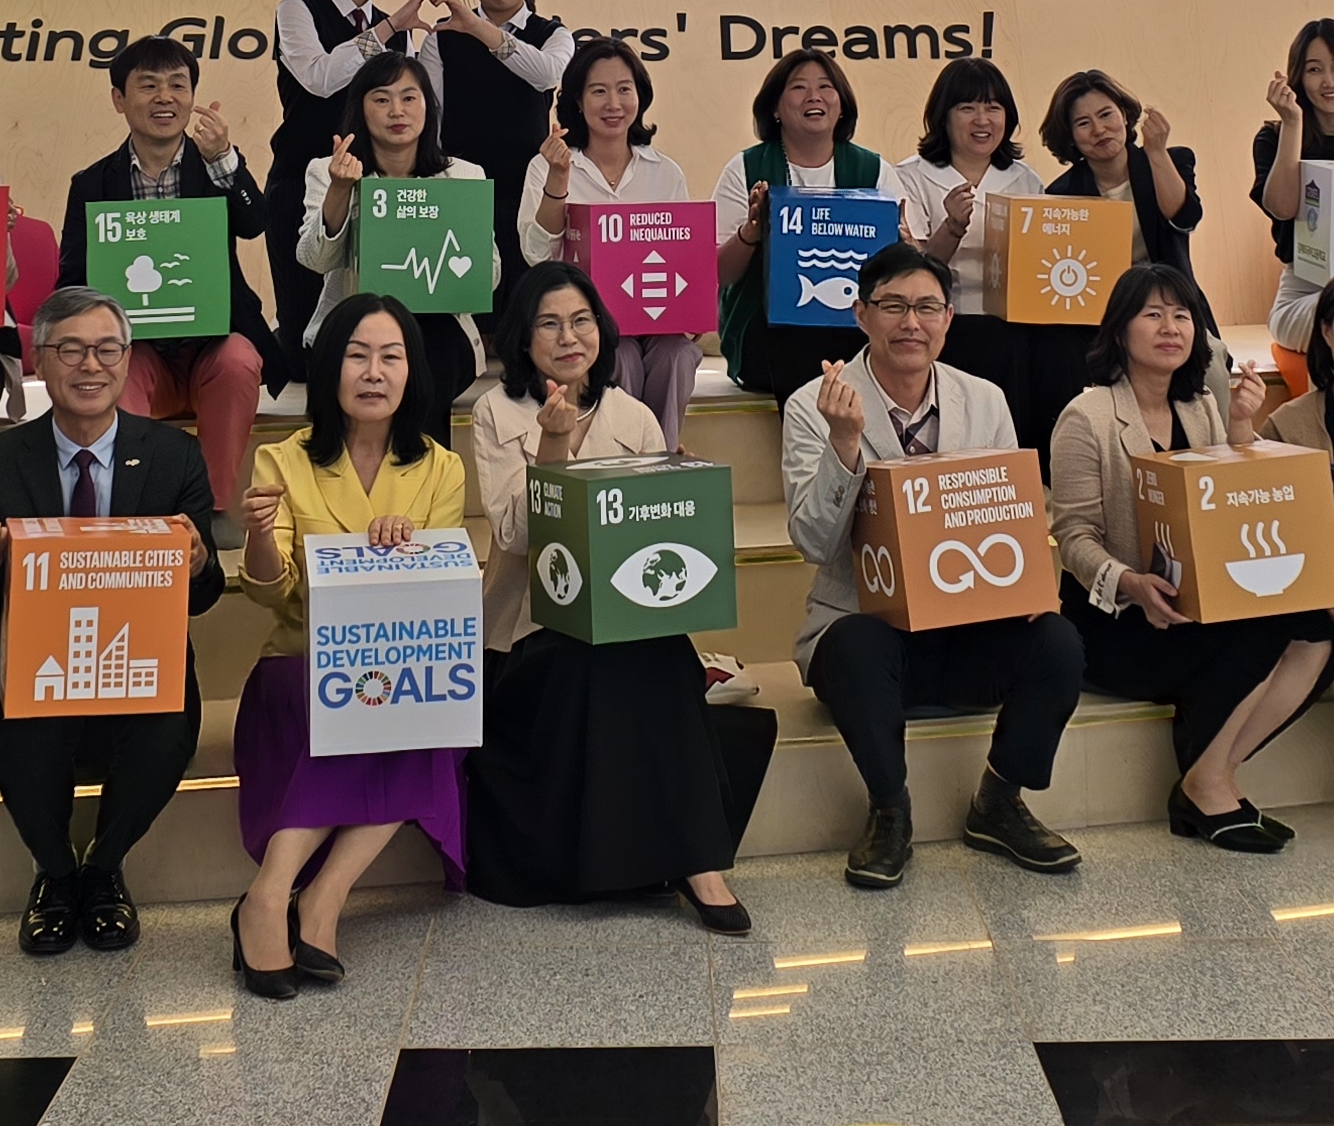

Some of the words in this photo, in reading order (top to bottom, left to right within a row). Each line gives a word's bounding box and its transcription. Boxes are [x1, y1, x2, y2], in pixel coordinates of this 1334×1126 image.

[719, 11, 996, 62] Dreams!
[372, 189, 387, 218] 3
[396, 189, 427, 203] 건강한
[125, 210, 147, 225] 육상
[148, 209, 181, 224] 생태계
[396, 206, 417, 219] 삶의
[418, 205, 440, 219] 보장
[630, 212, 672, 226] REDUCED
[779, 206, 803, 235] 14
[812, 207, 831, 221] LIFE
[1020, 207, 1034, 234] 7
[1042, 207, 1089, 221] 지속가능한
[94, 212, 122, 243] 15
[125, 228, 147, 241] 보호
[598, 214, 623, 243] 10
[630, 227, 691, 242] INEQUALITIES
[811, 222, 845, 236] BELOW
[845, 223, 876, 239] WATER
[1042, 223, 1071, 236] 에너지
[938, 466, 1008, 491] RESPONSIBLE
[529, 479, 542, 514] 13
[902, 477, 932, 515] 12
[941, 484, 1016, 510] CONSUMPTION
[1198, 476, 1216, 511] 2
[1226, 488, 1271, 507] 지속가능
[1272, 485, 1295, 502] 농업
[596, 488, 624, 525] 13
[628, 503, 672, 522] 기후변화
[673, 500, 695, 517] 대응
[944, 510, 967, 529] AND
[967, 502, 1034, 526] PRODUCTION
[59, 551, 144, 569] SUSTAINABLE
[144, 549, 184, 567] CITIES
[315, 540, 468, 559] GOALS
[22, 552, 50, 591] 11
[58, 573, 86, 590] AND
[87, 570, 173, 589] COMMUNITIES
[316, 617, 477, 646] SUSTAINABLE
[317, 641, 476, 669] DEVELOPMENT
[318, 663, 476, 709] GOALS
